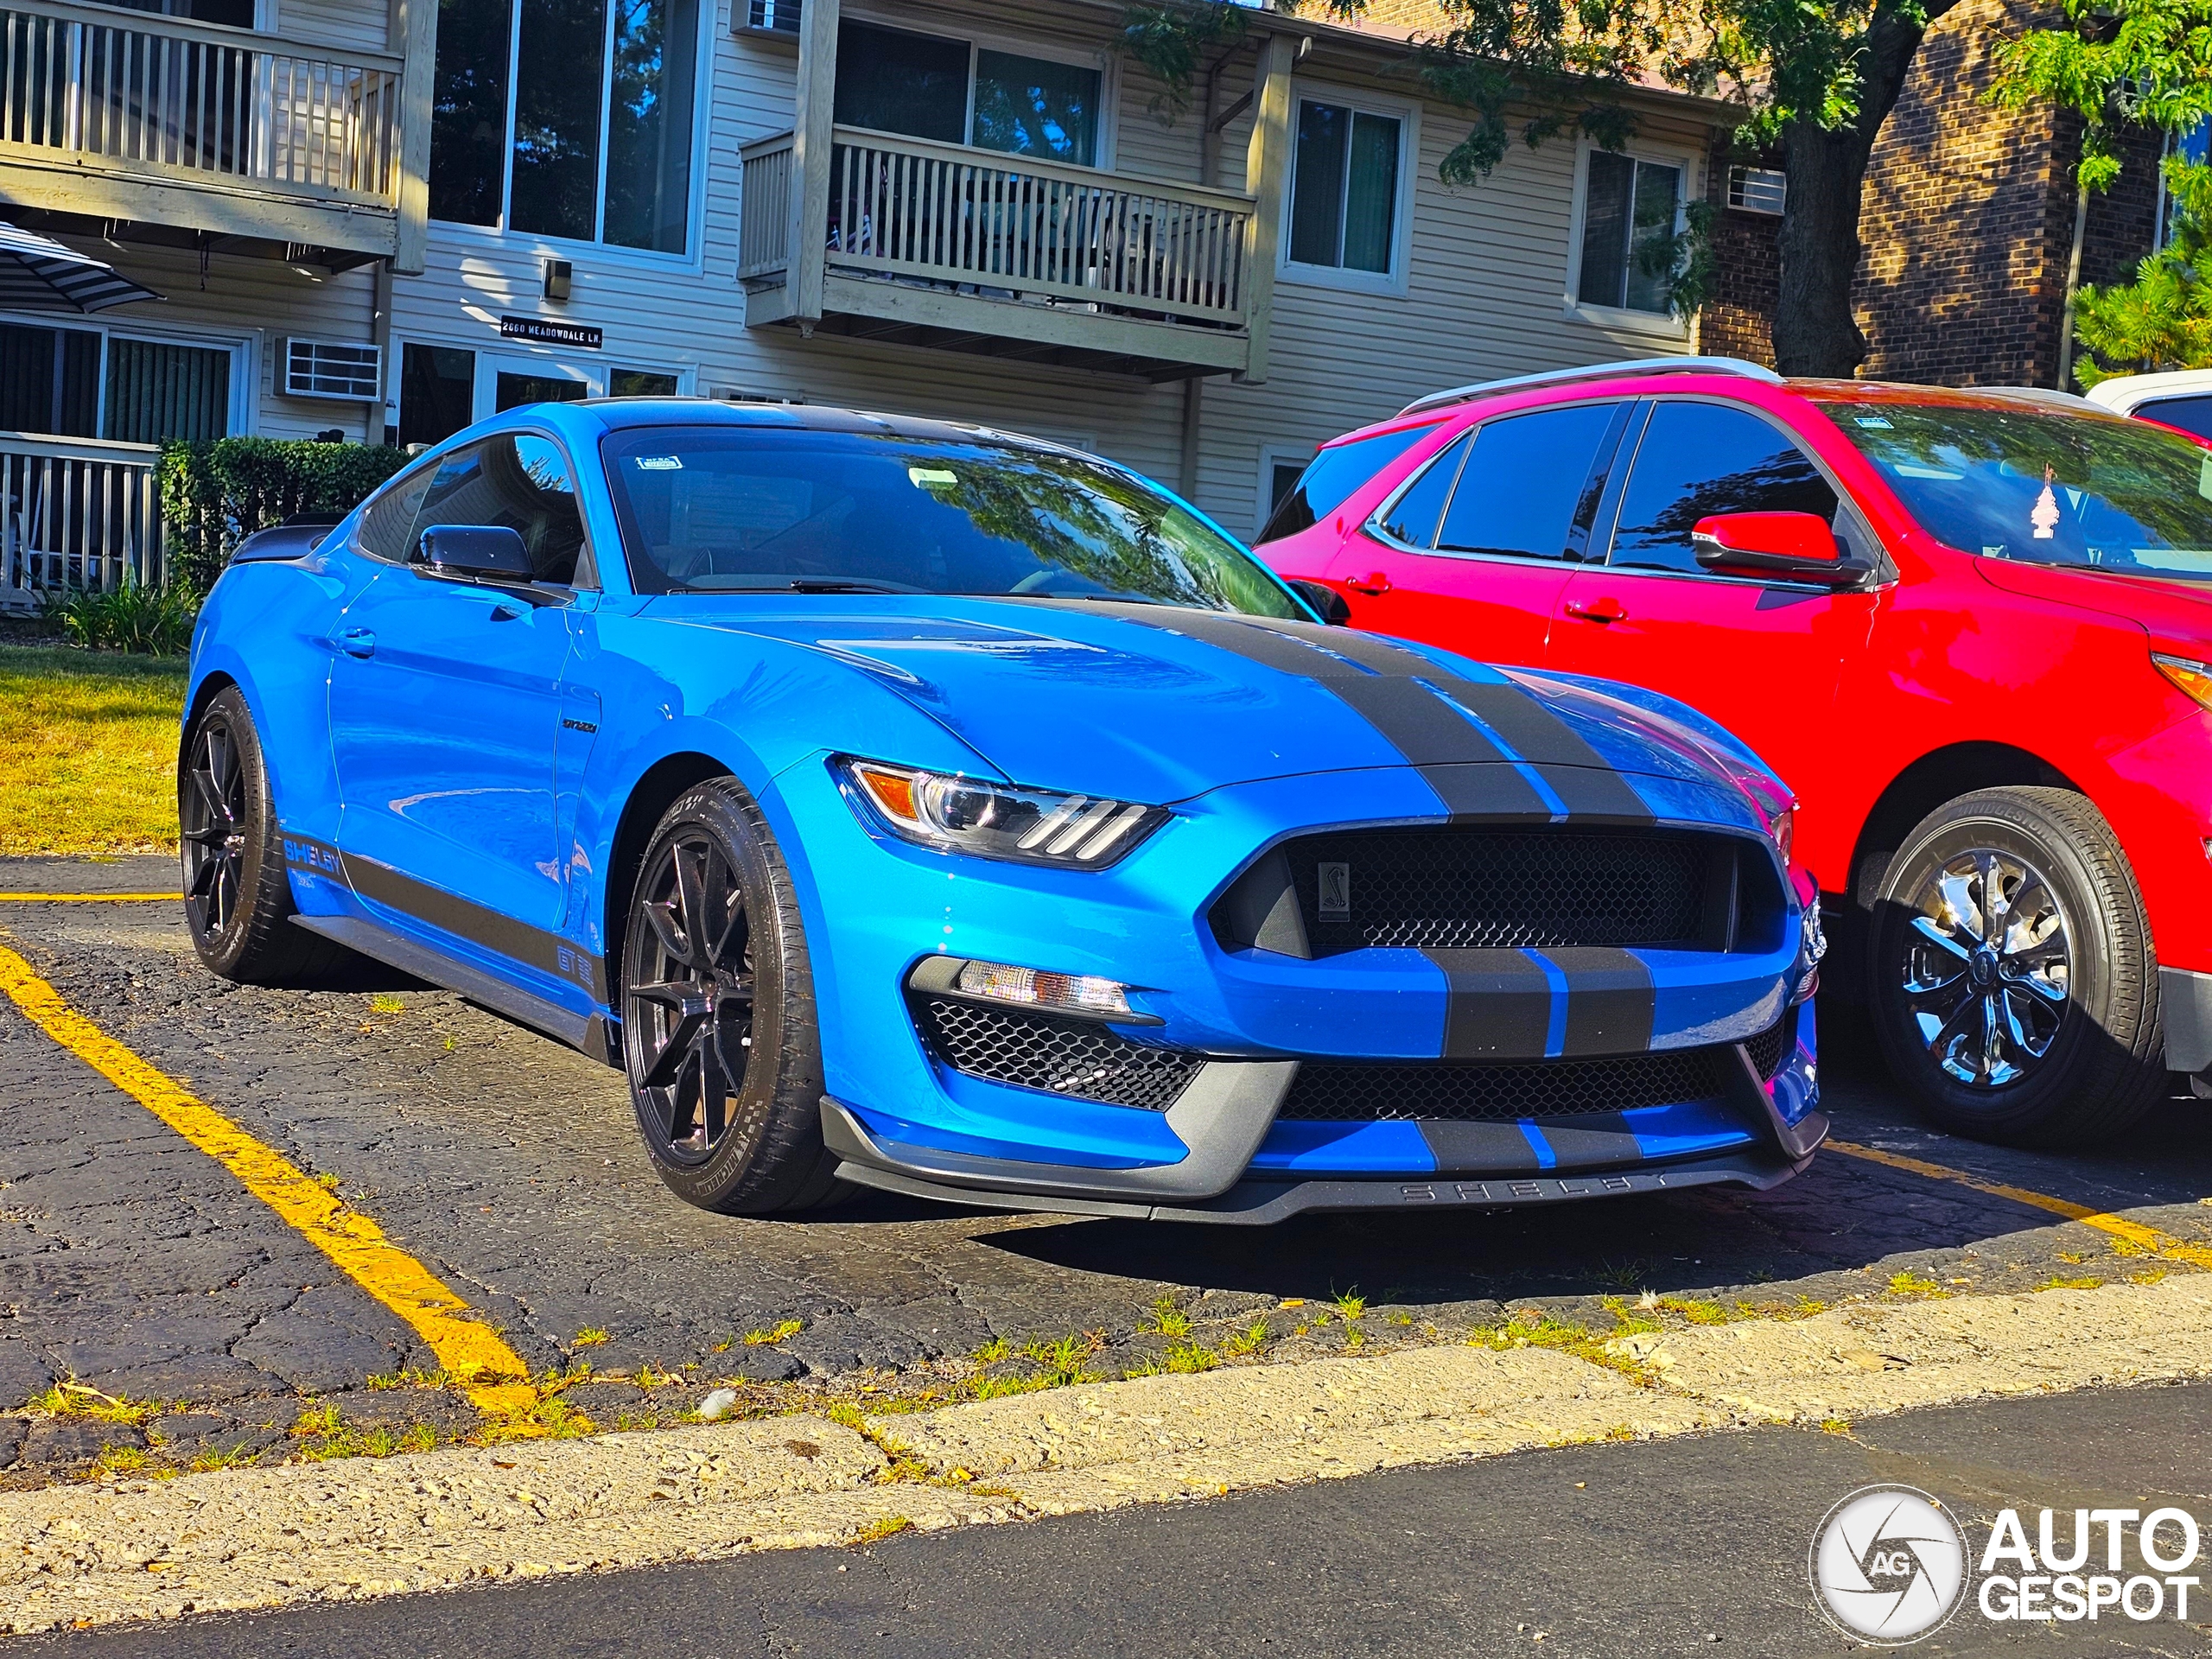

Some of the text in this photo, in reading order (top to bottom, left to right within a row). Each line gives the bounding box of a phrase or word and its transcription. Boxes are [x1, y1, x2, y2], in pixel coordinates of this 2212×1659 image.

[502, 321, 601, 344] 2660 MEADOWDALE LN.
[1958, 802, 2061, 846] BRIDGESTONE
[283, 839, 340, 876] SHELBY
[696, 1149, 741, 1197] MICHELIN
[1400, 1171, 1668, 1202] SHELBY
